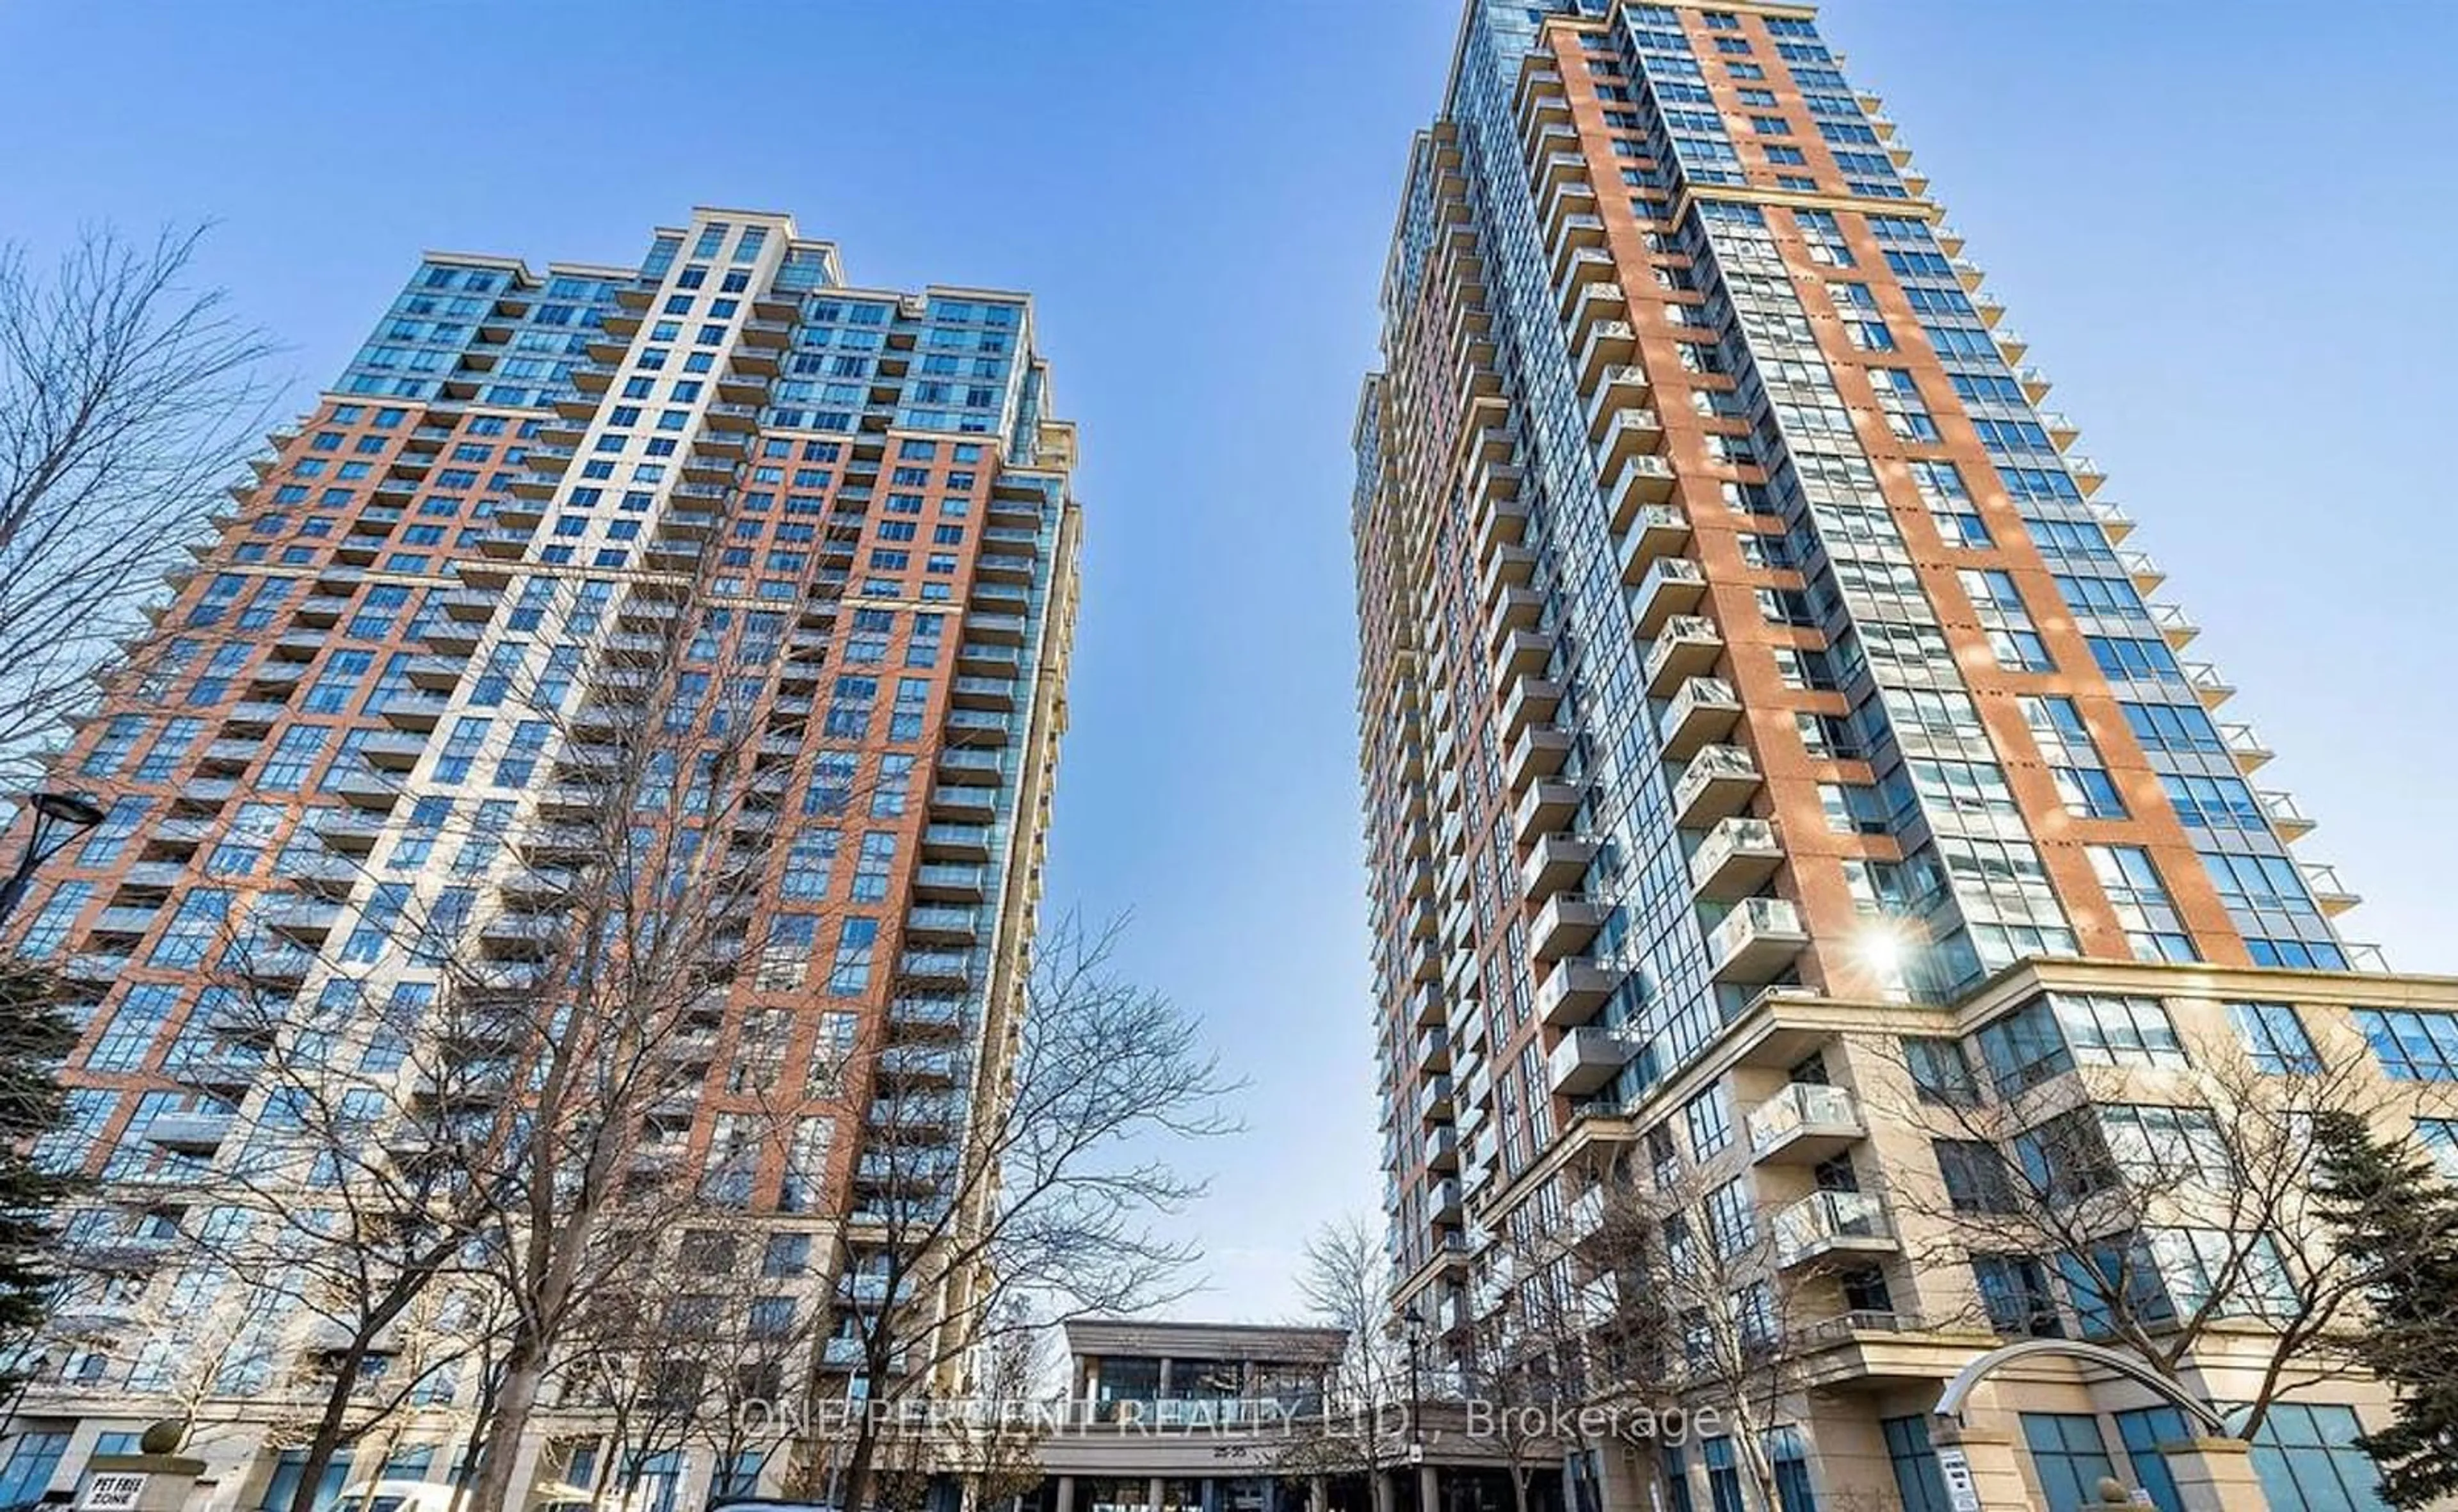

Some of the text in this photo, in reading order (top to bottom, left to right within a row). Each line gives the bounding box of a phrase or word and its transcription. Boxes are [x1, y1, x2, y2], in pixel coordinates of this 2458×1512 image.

[93, 1477, 143, 1493] PET FREE
[90, 1493, 131, 1505] ZONE
